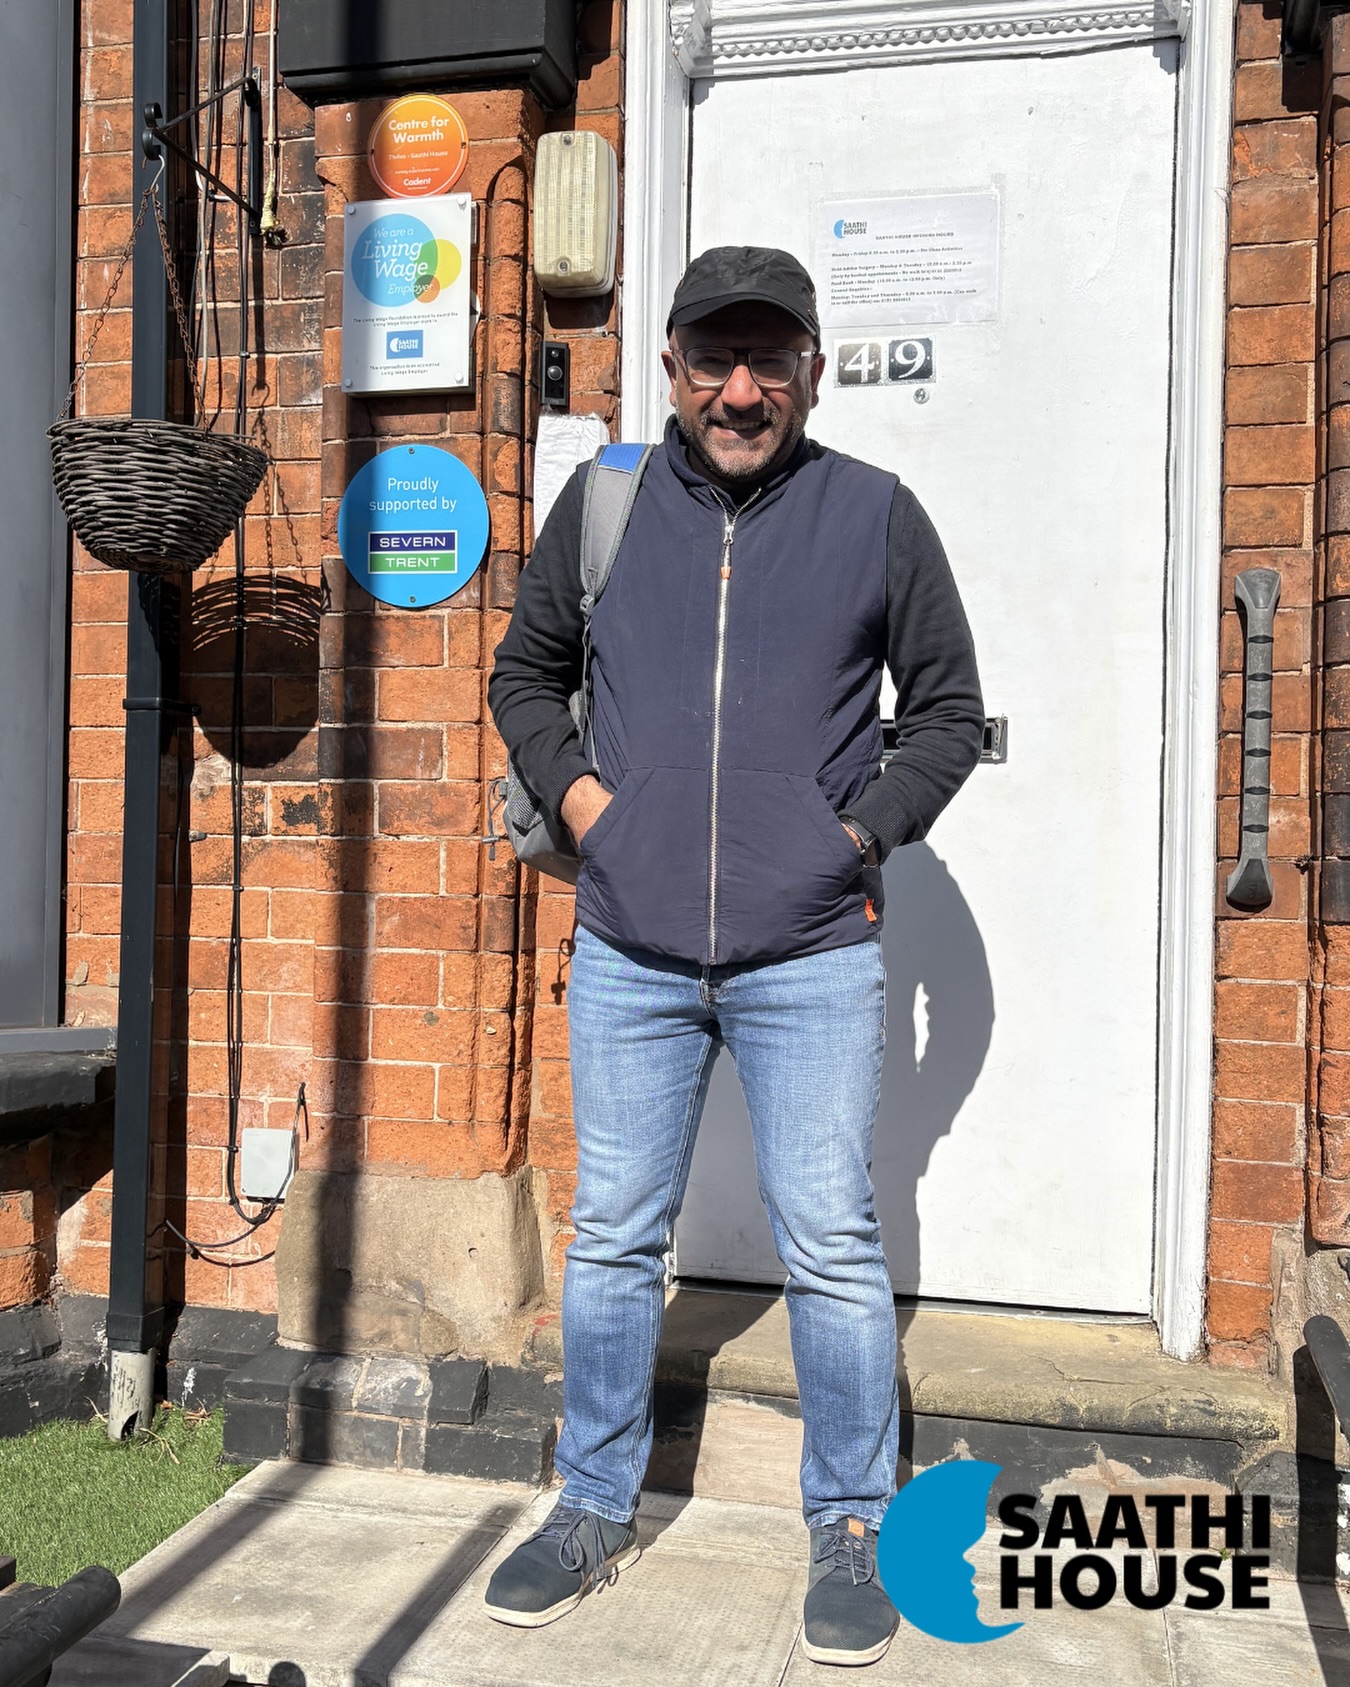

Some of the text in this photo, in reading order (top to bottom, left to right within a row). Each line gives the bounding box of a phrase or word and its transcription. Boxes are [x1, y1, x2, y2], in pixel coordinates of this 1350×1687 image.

[389, 115, 450, 131] Centre for
[393, 129, 444, 143] Warmth
[403, 177, 431, 186] Cadent
[844, 221, 867, 229] SAATHI
[374, 228, 414, 238] We are a
[362, 239, 422, 260] Living
[374, 258, 428, 281] Wage
[388, 283, 434, 296] Employer
[844, 340, 926, 383] 49
[387, 477, 439, 493] Proudly
[369, 496, 457, 513] supported by
[379, 537, 446, 548] SEVERN
[384, 557, 440, 568] TRENT
